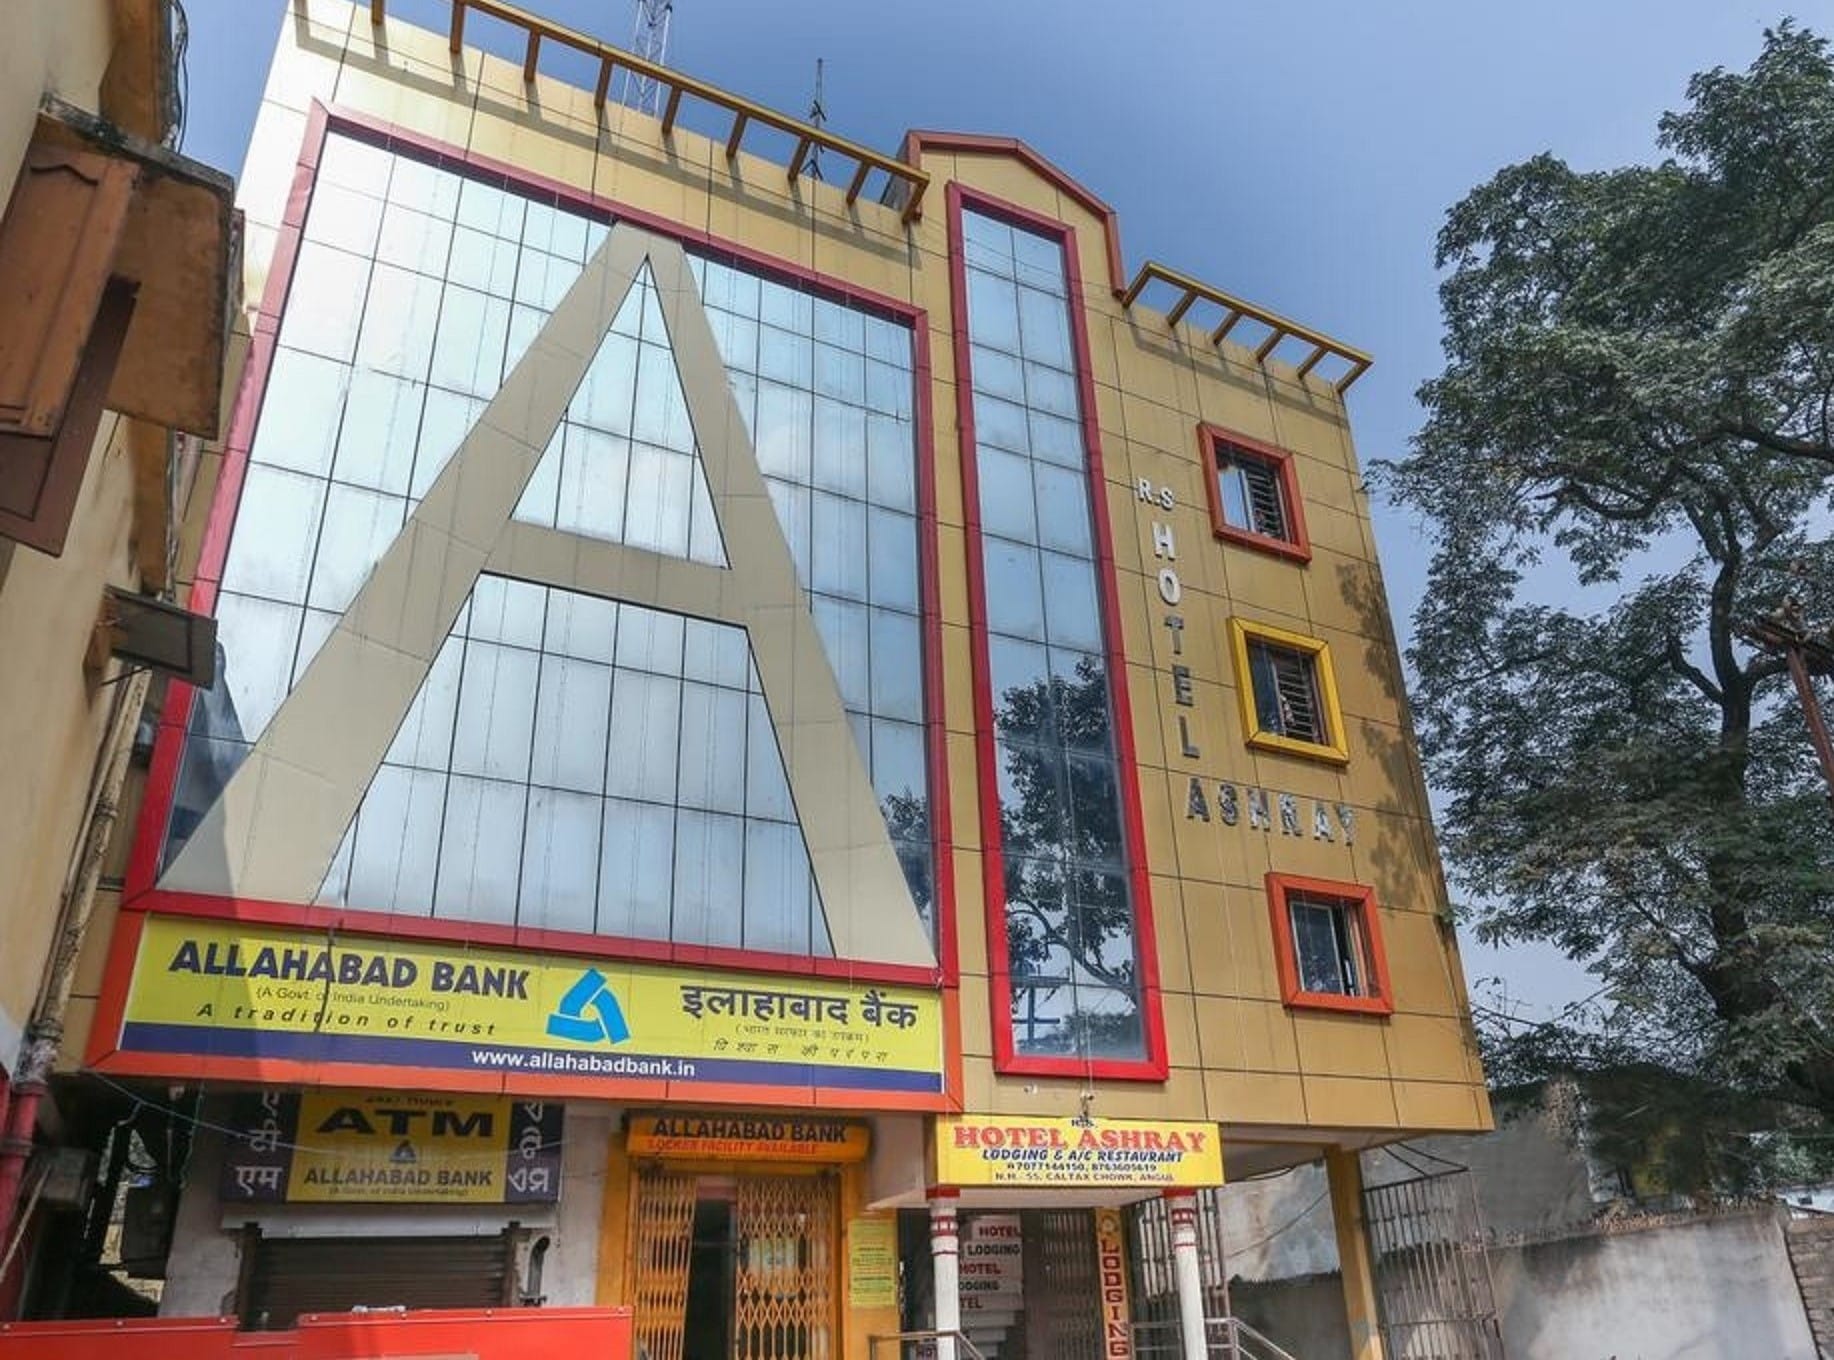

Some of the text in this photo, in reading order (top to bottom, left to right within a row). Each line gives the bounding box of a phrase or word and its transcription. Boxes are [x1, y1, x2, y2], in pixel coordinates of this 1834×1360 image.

[1153, 521, 1200, 760] HOTEL
[1186, 777, 1356, 847] ASHRAY
[168, 940, 531, 1000] ALLAHABAD BANK
[196, 1003, 213, 1017] A
[387, 1015, 415, 1029] of
[429, 1018, 496, 1036] trust
[681, 985, 919, 1030] इलाहाबाद बैंक
[471, 1050, 695, 1077] www.allahabadbank.in
[316, 1107, 495, 1138] ATM
[652, 1118, 848, 1142] ALLAHABAD BANK
[953, 1126, 1206, 1153] HOTEL ASHRAY
[982, 1148, 1049, 1161] LODGING
[1068, 1150, 1093, 1161] A/C
[1097, 1151, 1184, 1163] RESTAURANT
[303, 1167, 493, 1187] ALLAHABAD BANK
[978, 1224, 1021, 1238] HOTEL
[967, 1243, 1021, 1256] LODGING
[958, 1280, 1000, 1291] ODGING
[1101, 1239, 1130, 1357] LODGING
[960, 1297, 983, 1309] TEL
